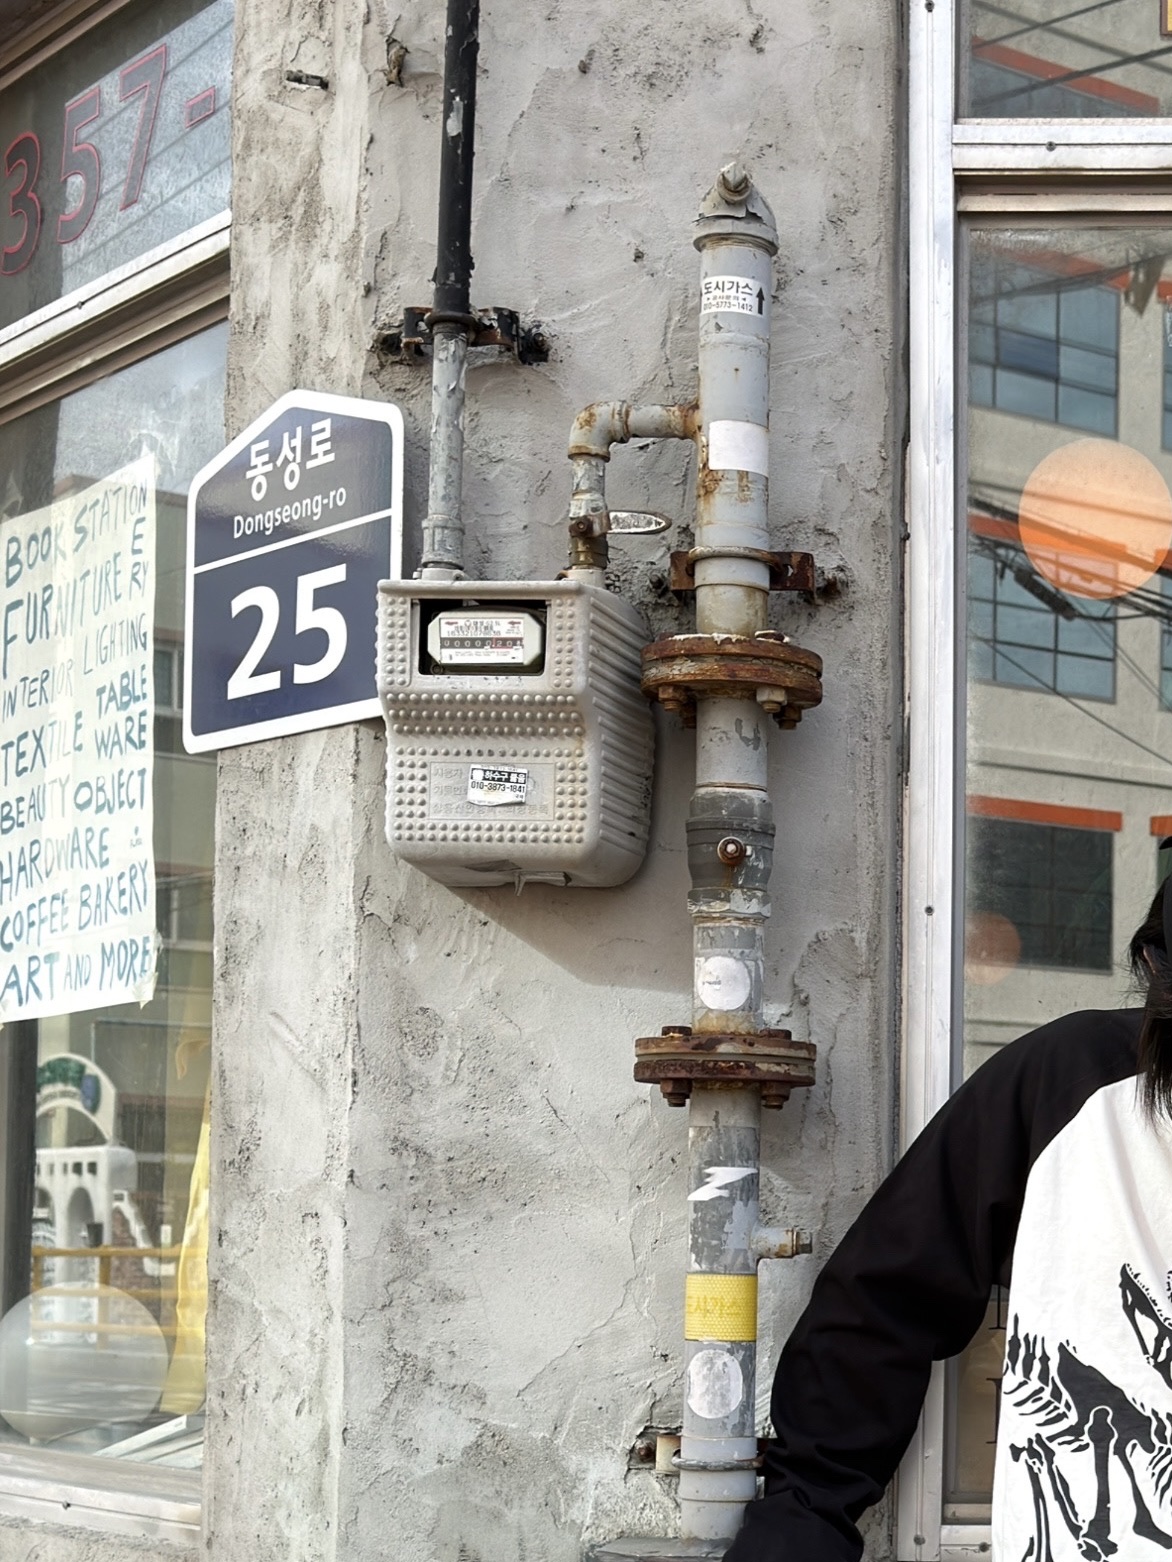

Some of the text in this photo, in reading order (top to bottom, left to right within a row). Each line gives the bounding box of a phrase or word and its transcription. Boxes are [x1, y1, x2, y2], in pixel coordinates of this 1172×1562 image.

[704, 281, 753, 296] 도시가스
[245, 418, 335, 501] 동성로
[5, 478, 148, 589] BOOK STATION
[234, 487, 347, 539] Dongseong-ro
[3, 551, 121, 679] FURNITURE
[227, 563, 348, 700] 25
[2, 612, 147, 723] INTERIOR LIGHTING
[1, 664, 147, 787] TEXTILE TABLE
[95, 709, 147, 759] WARE
[1, 767, 147, 835] BEAUTY OBJECT
[470, 781, 526, 793] 010-3873-1841
[0, 827, 110, 905] HARDWARE
[0, 859, 149, 952] COFFEE BAKERY
[0, 936, 151, 1007] ART AND MORE
